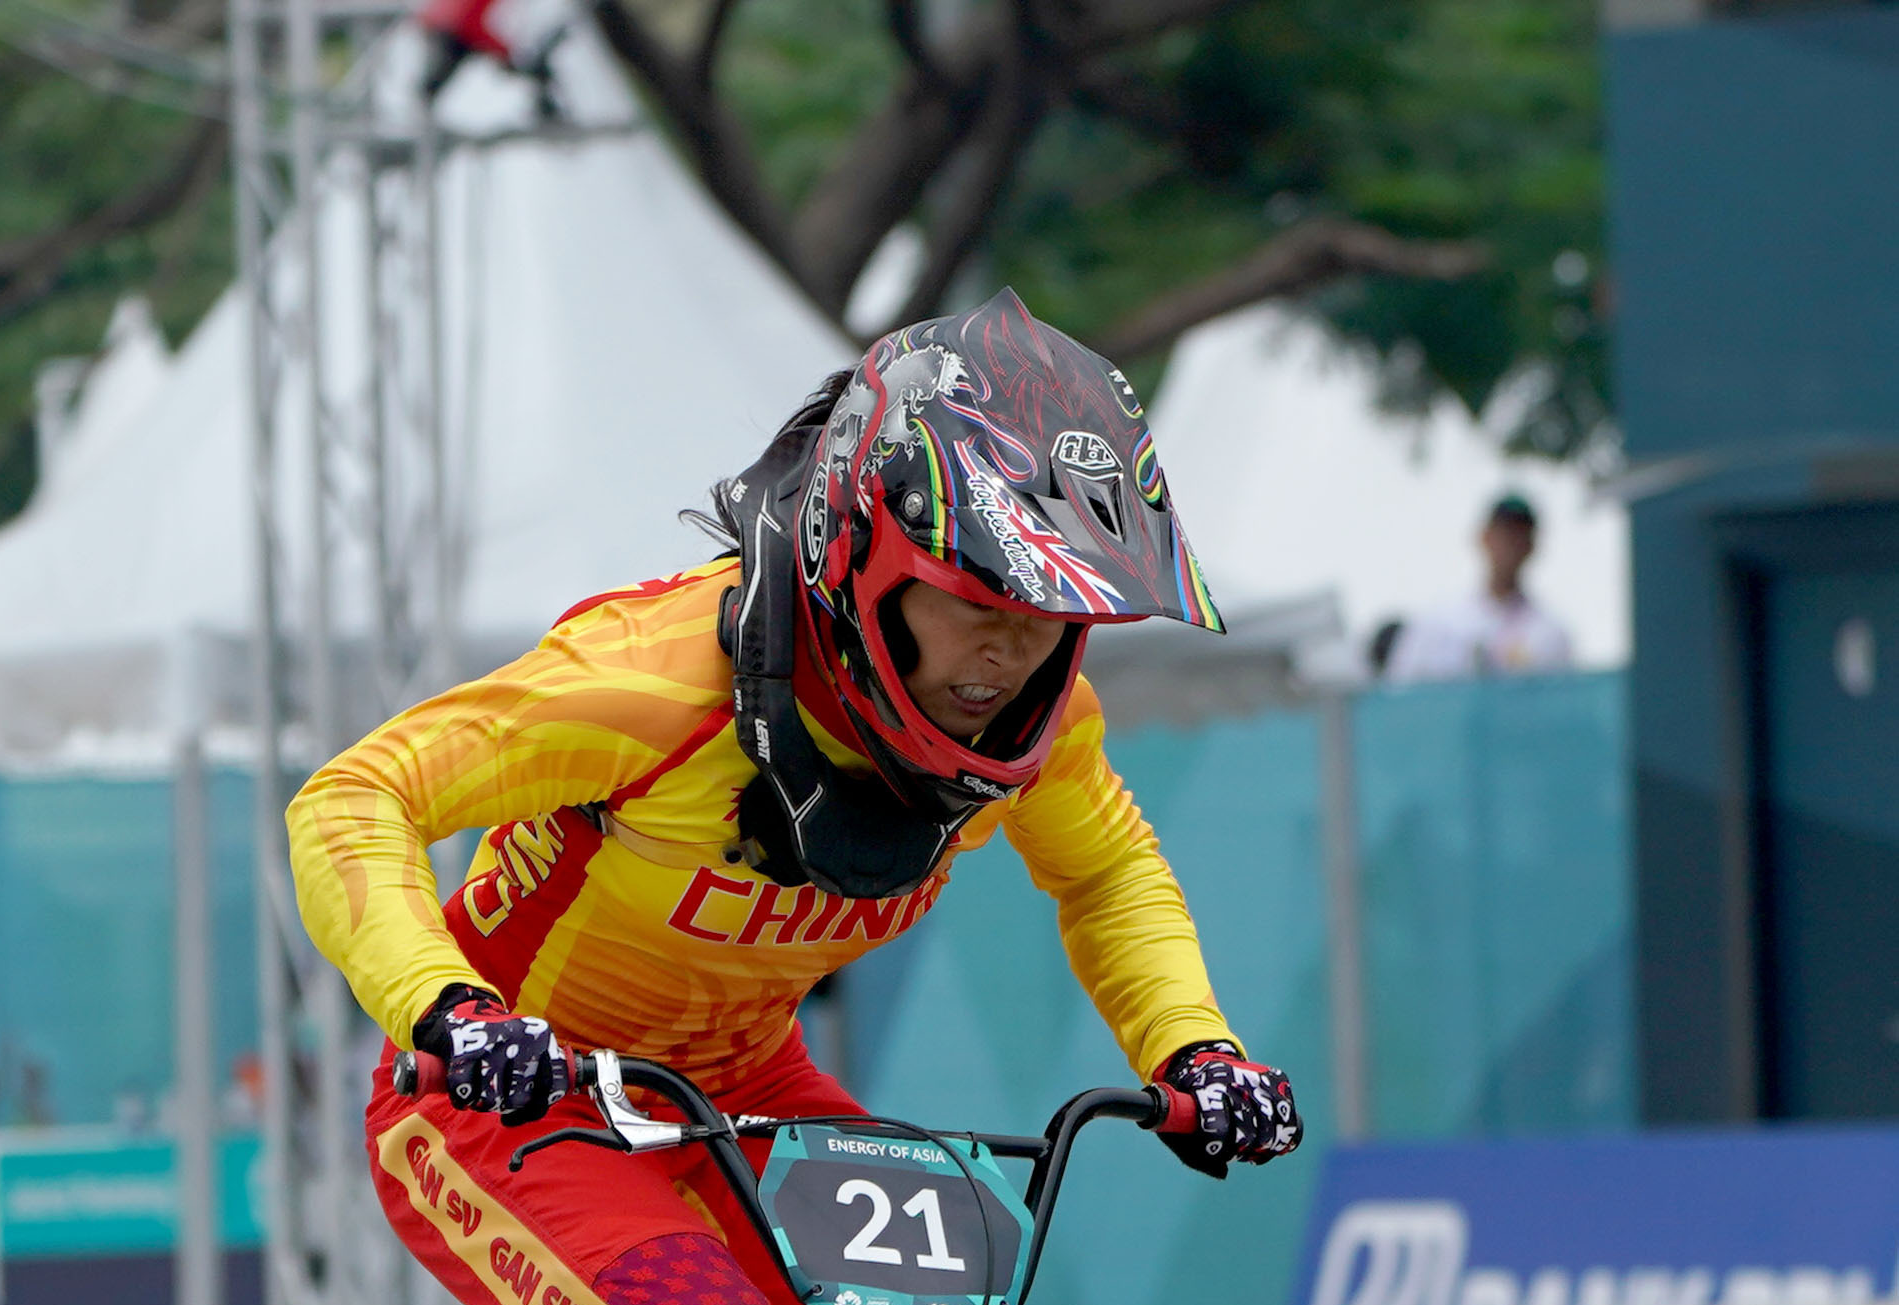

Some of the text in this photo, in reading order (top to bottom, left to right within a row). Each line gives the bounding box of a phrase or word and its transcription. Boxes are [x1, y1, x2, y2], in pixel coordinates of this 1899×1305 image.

[983, 508, 1010, 538] Lee
[999, 537, 1045, 603] Designs
[754, 717, 771, 764] LEATT
[405, 1135, 483, 1238] GAN SU
[827, 1137, 947, 1164] ENERGY OF ASIA
[835, 1178, 966, 1272] 21
